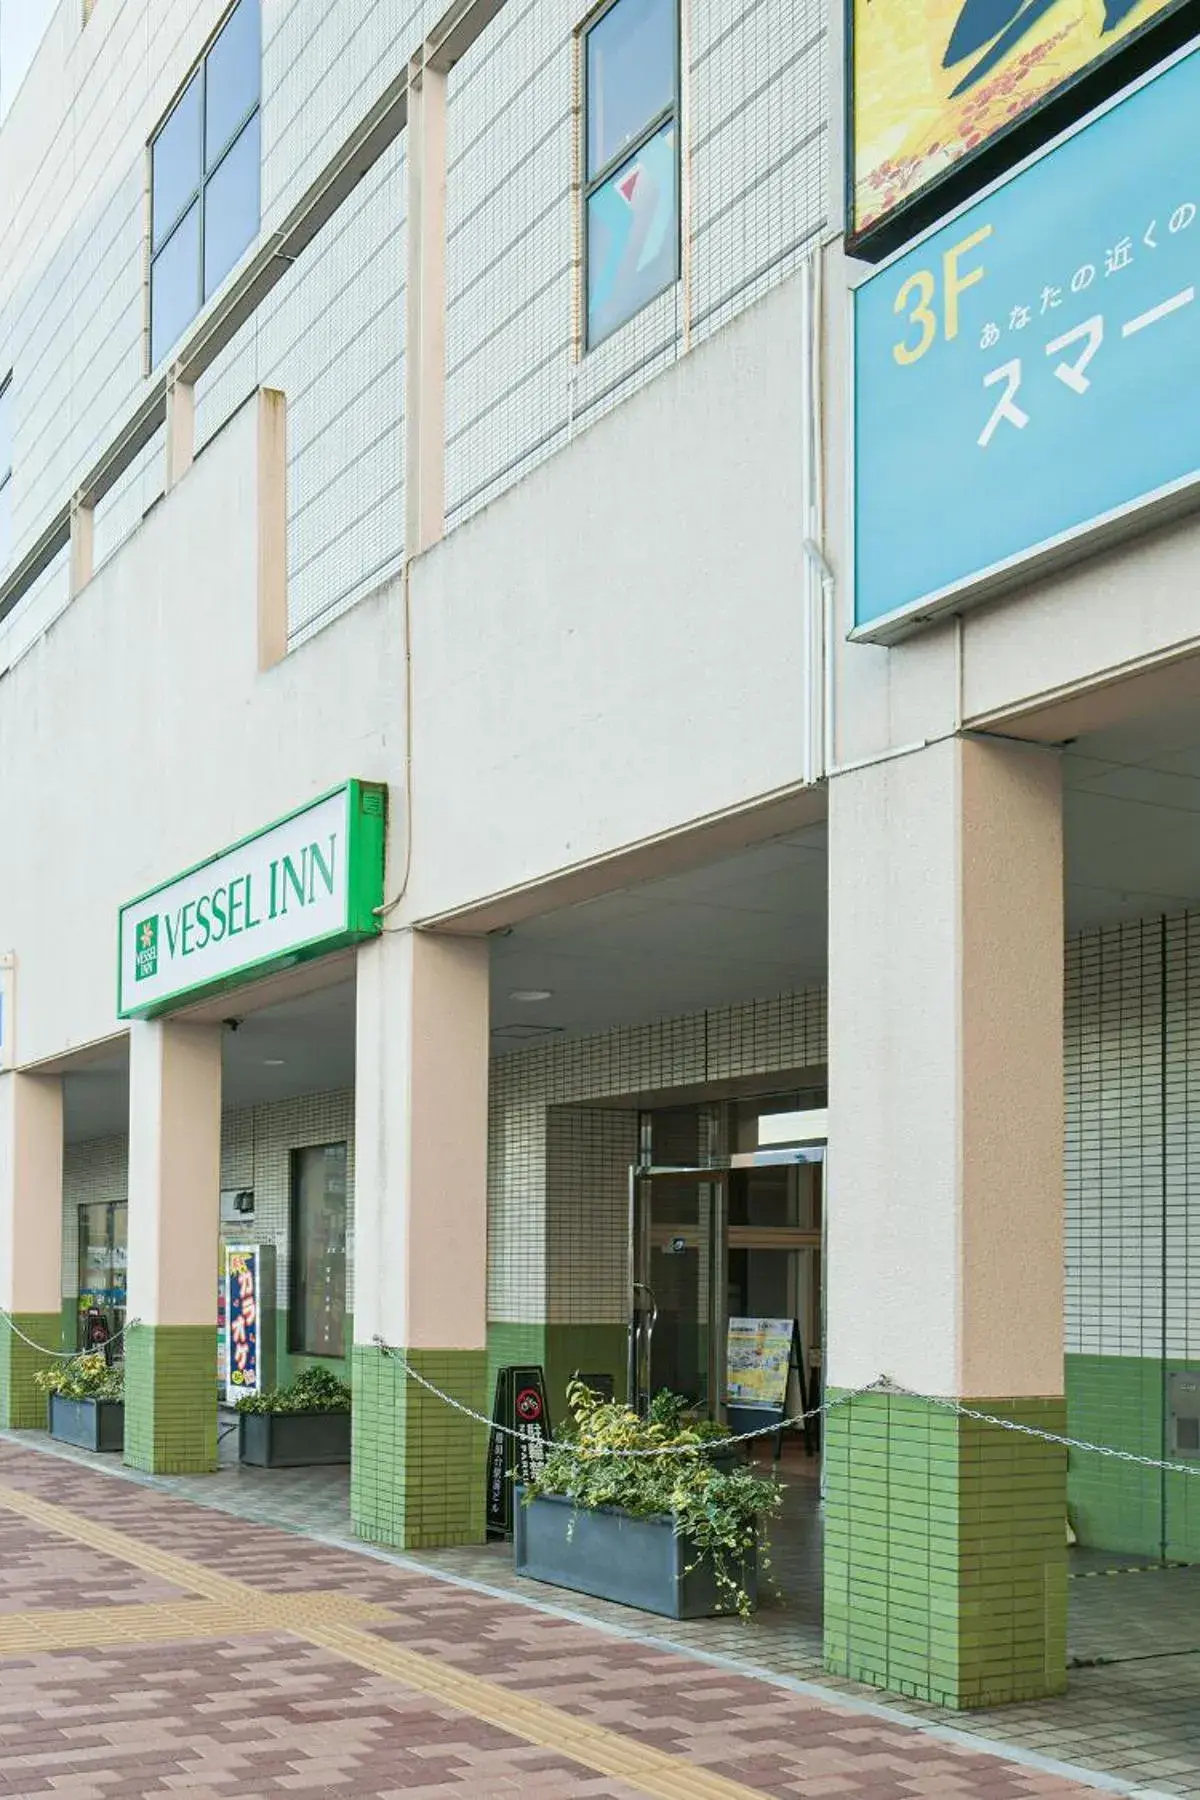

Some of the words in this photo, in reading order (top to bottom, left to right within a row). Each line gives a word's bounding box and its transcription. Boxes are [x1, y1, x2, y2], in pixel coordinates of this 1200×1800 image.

[892, 224, 995, 366] 3F
[979, 202, 1197, 350] あなたの近くの
[164, 873, 260, 960] VESSEL
[268, 833, 337, 920] INN
